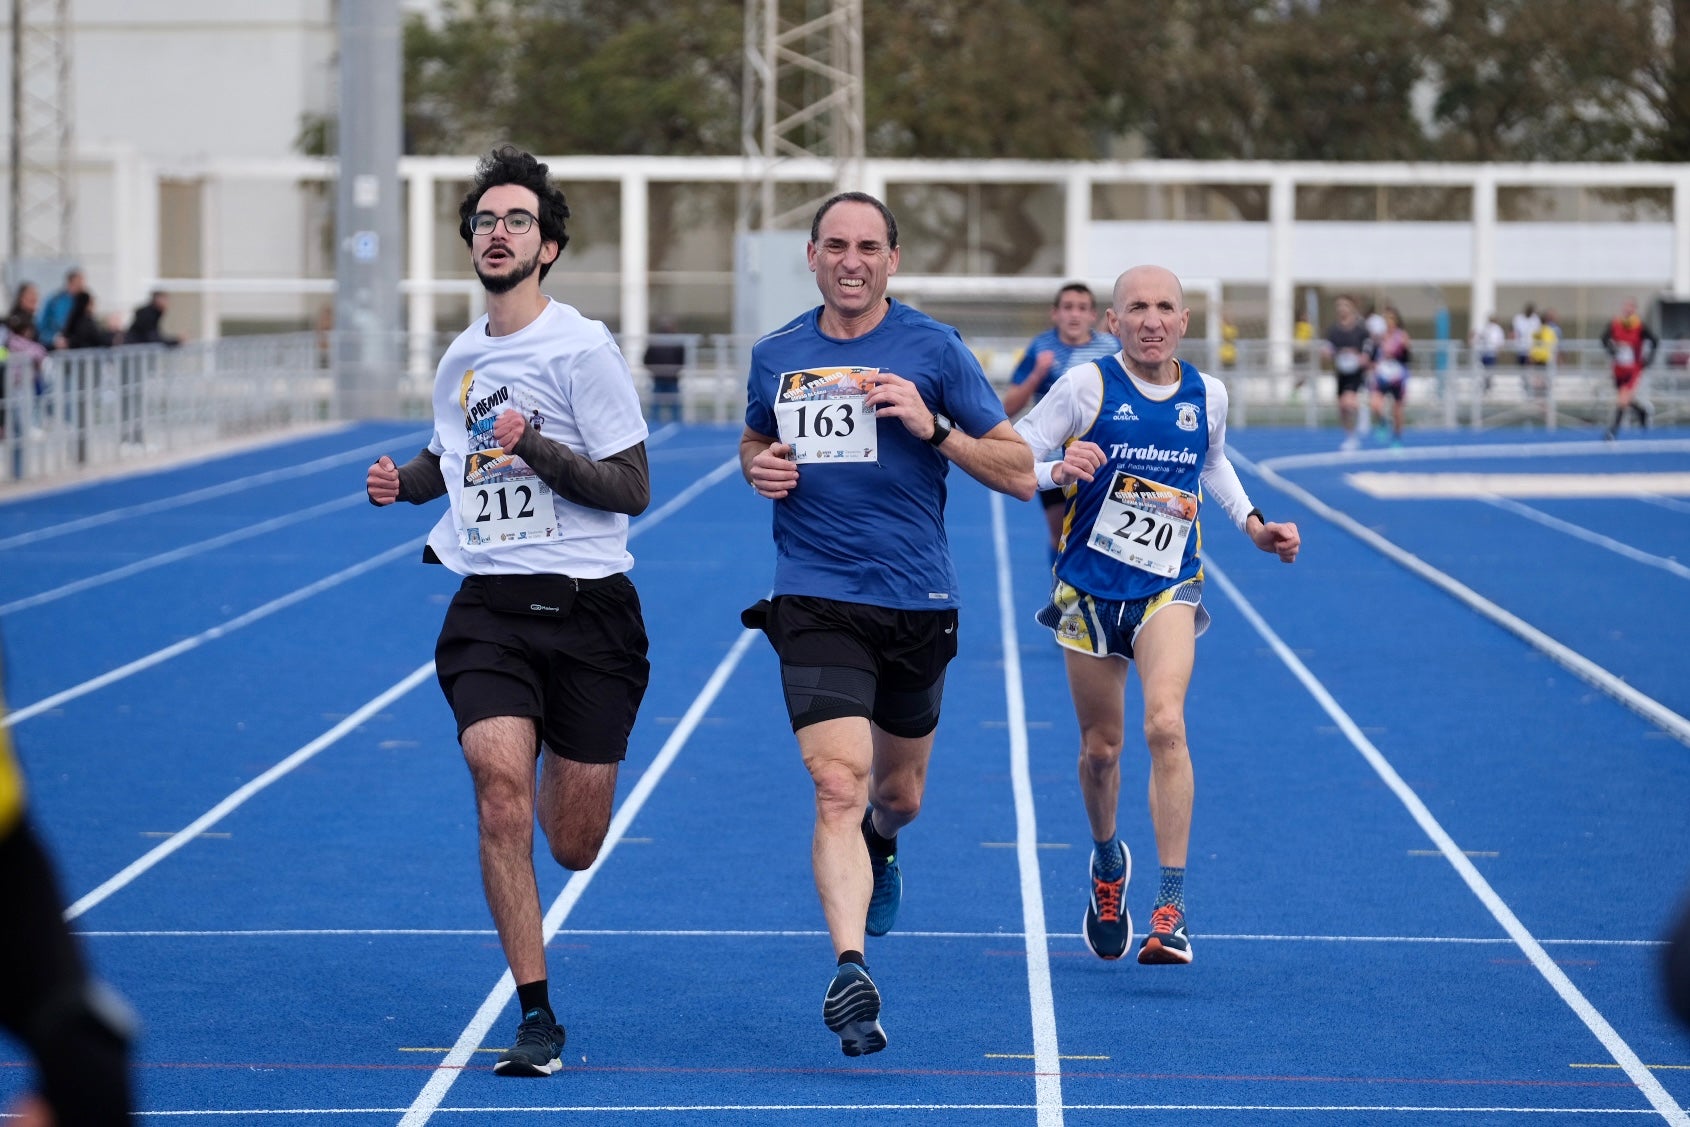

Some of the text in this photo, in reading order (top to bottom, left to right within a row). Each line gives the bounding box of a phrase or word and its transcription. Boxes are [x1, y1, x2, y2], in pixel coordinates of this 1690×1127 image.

[783, 372, 843, 399] GRAN PREMIO
[470, 386, 508, 422] PREMIO
[794, 404, 854, 438] 163
[1110, 443, 1198, 465] Tirabuzón
[466, 467, 484, 482] GRAN
[476, 485, 534, 522] 212
[1115, 491, 1174, 499] GRAN PREMIO
[1113, 510, 1173, 551] 220
